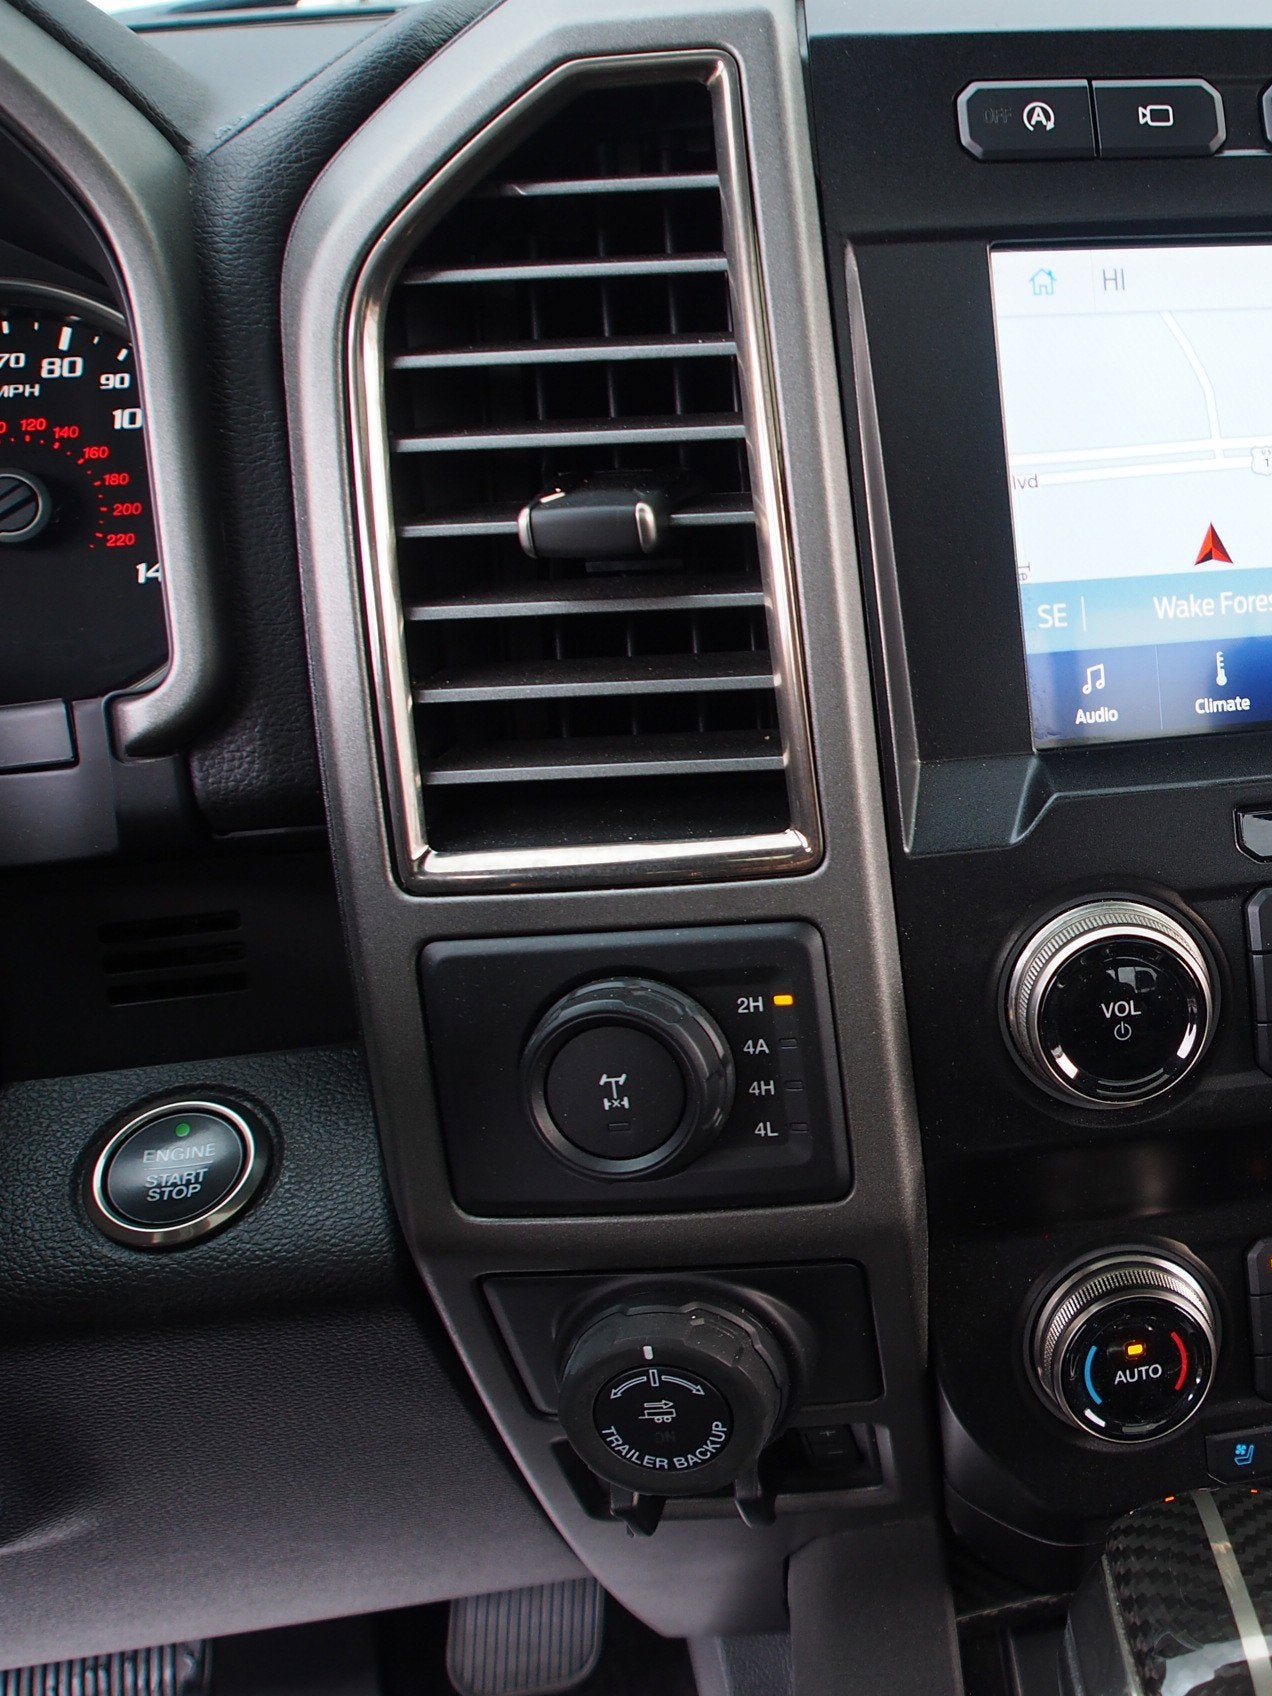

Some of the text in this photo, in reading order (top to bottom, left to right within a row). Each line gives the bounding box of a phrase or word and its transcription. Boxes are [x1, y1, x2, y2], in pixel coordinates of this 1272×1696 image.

[1102, 269, 1125, 291] HI
[40, 356, 84, 379] 80
[99, 373, 131, 390] 90
[20, 418, 47, 431] 120
[52, 425, 80, 439] 140
[82, 446, 110, 459] 160
[1265, 458, 1269, 467] 1
[103, 473, 130, 486] 180
[112, 502, 143, 516] 200
[105, 533, 136, 547] 220
[1153, 594, 1215, 620] Wake
[1037, 603, 1068, 629] SE
[1194, 696, 1251, 715] Climate
[1075, 708, 1119, 725] Audio
[736, 996, 764, 1014] 2H
[1101, 1000, 1142, 1019] VOL
[743, 1038, 770, 1055] 4A
[749, 1080, 775, 1096] 4H
[754, 1121, 779, 1137] 4L
[142, 1142, 216, 1164] ENGINE
[145, 1168, 209, 1188] START
[147, 1184, 201, 1202] STOP
[1114, 1364, 1162, 1385] AUTO
[602, 1420, 727, 1470] TRAILER BACKUP
